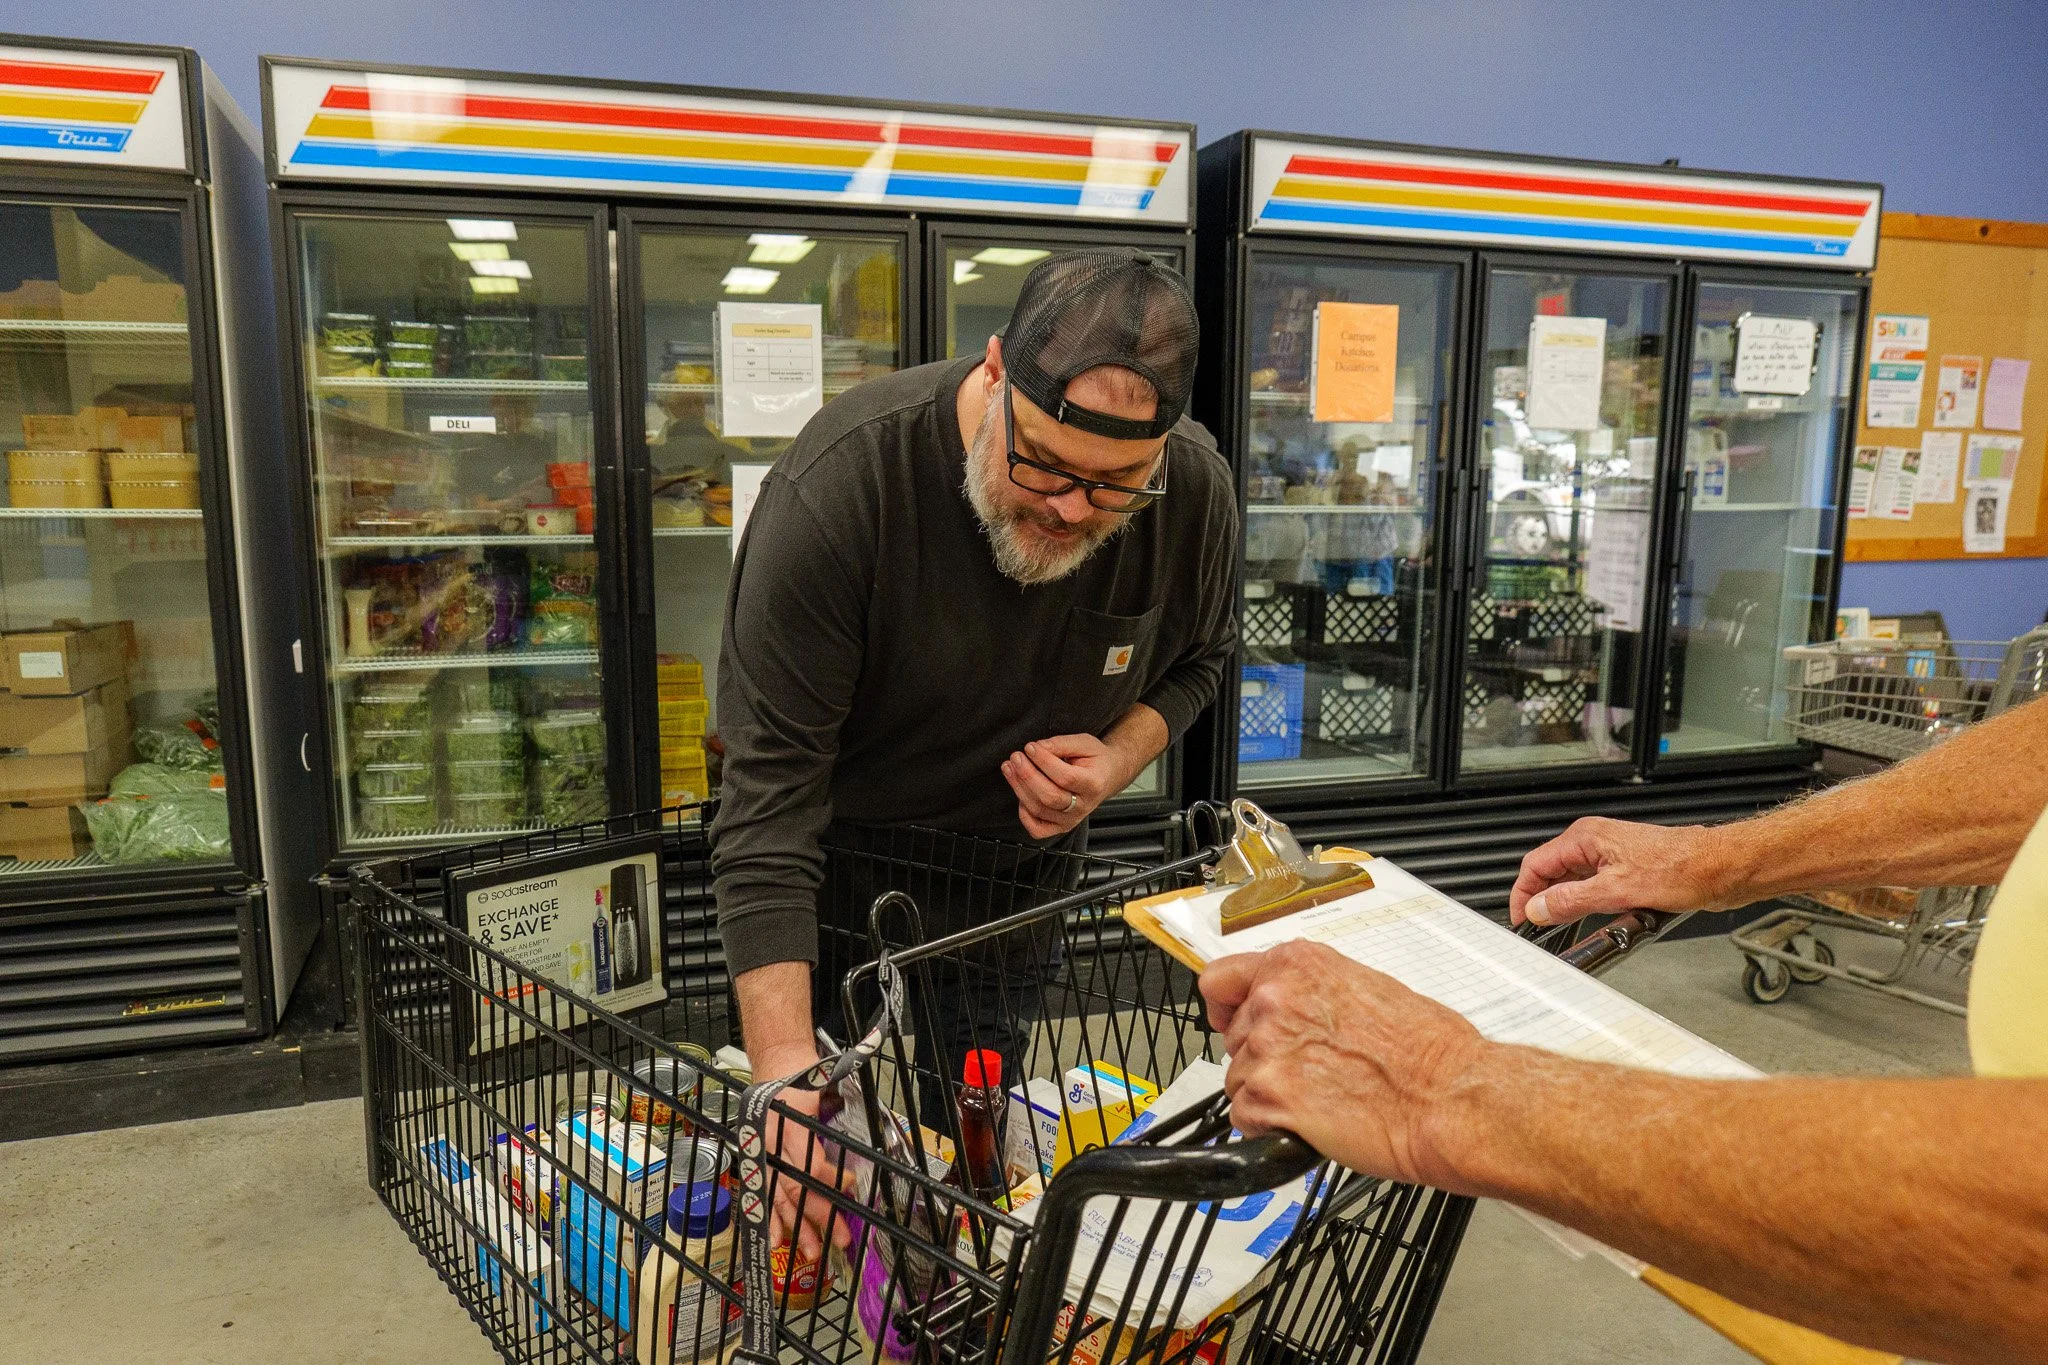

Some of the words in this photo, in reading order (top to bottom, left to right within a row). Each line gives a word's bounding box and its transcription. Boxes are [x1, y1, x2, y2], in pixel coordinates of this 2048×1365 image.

[47, 130, 113, 147] True
[1341, 330, 1377, 343] Campus
[446, 419, 471, 430] DELI
[490, 878, 558, 901] sodastream
[478, 897, 560, 928] EXCHANGE
[480, 928, 494, 946] &
[529, 938, 550, 949] EMPTY
[529, 947, 543, 957] FOR
[544, 961, 562, 971] SAVE
[1041, 1120, 1058, 1136] FOO
[1024, 1138, 1054, 1162] Panake
[749, 1228, 758, 1242] Do
[1087, 1209, 1142, 1250] REUABLE
[750, 1243, 759, 1260] Not
[758, 1237, 766, 1268] Please
[751, 1261, 760, 1288] Leave
[760, 1268, 769, 1298] Fasten
[753, 1289, 761, 1313] Child
[762, 1299, 771, 1323] Child
[753, 1314, 763, 1352] Unatten
[762, 1325, 772, 1355] Secure
